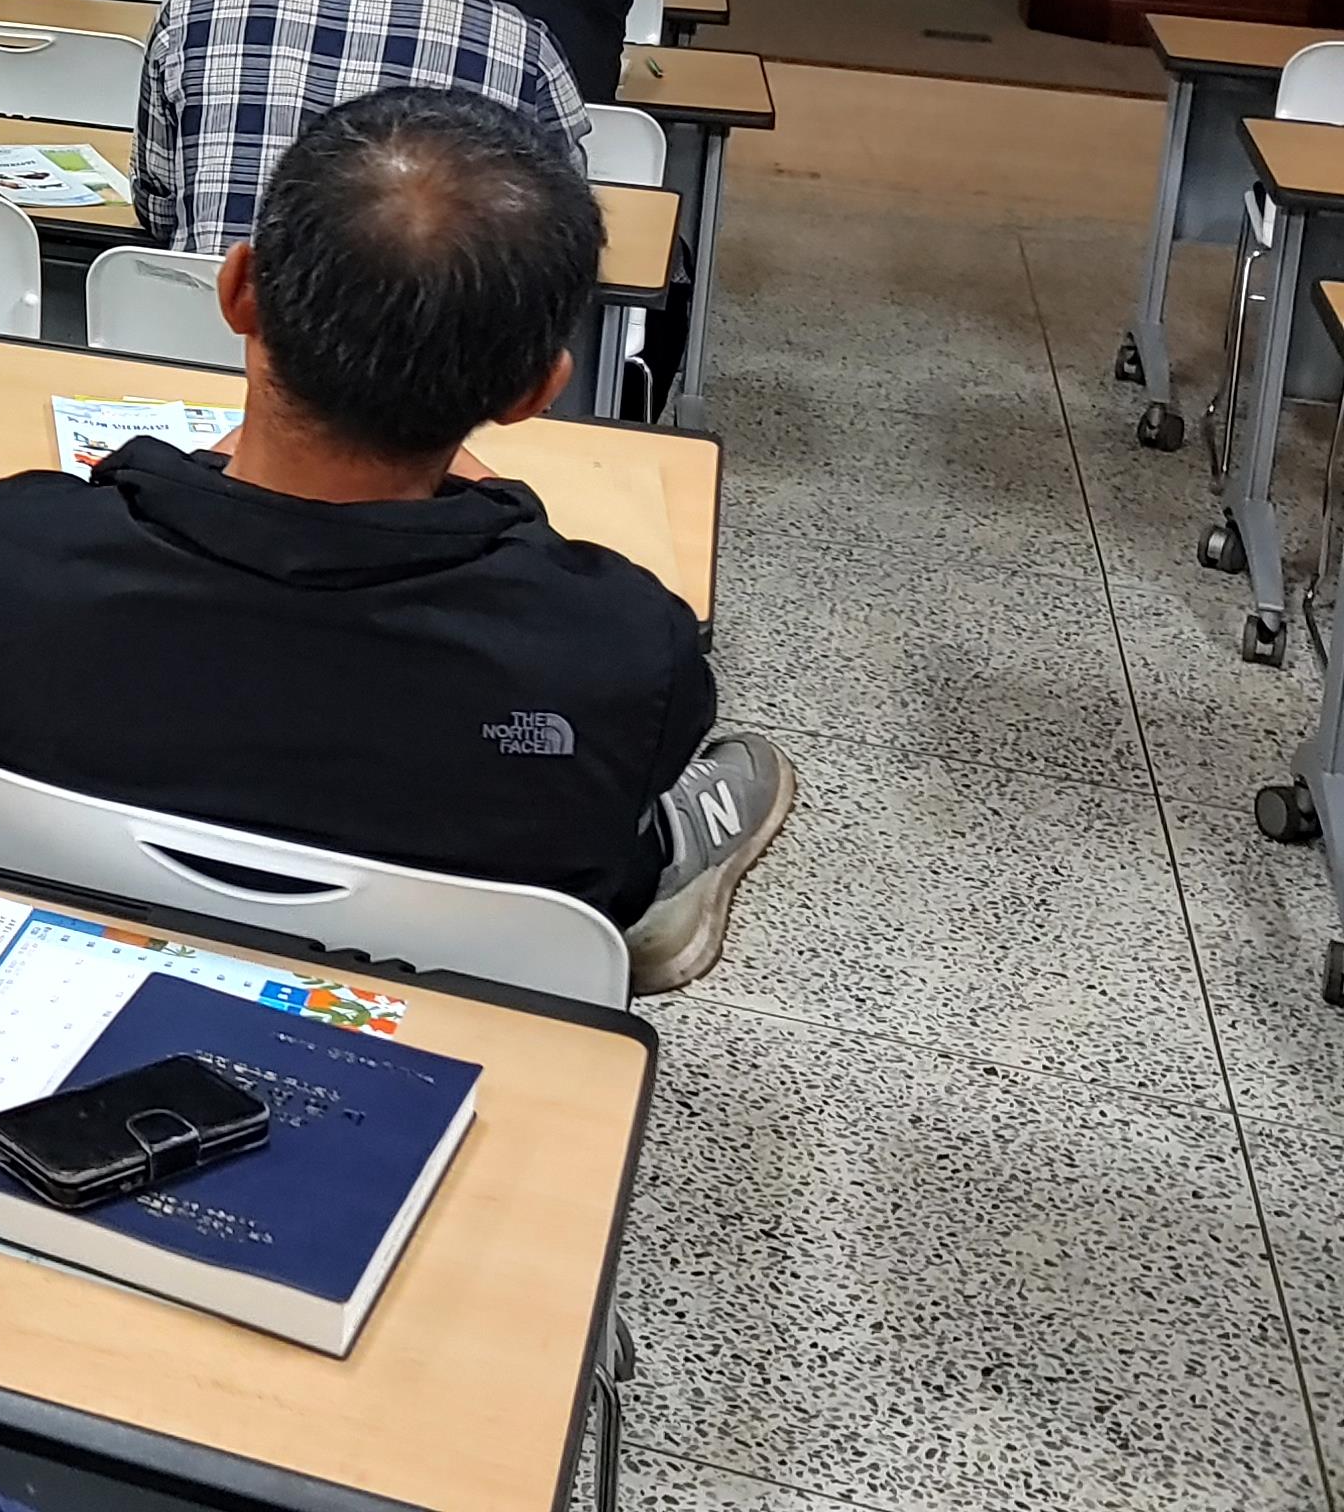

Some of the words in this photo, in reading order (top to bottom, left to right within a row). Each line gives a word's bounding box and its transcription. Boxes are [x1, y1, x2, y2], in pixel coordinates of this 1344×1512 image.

[511, 711, 547, 728] THE
[482, 723, 547, 740] NORTH
[499, 739, 547, 754] FACE
[698, 779, 742, 847] N
